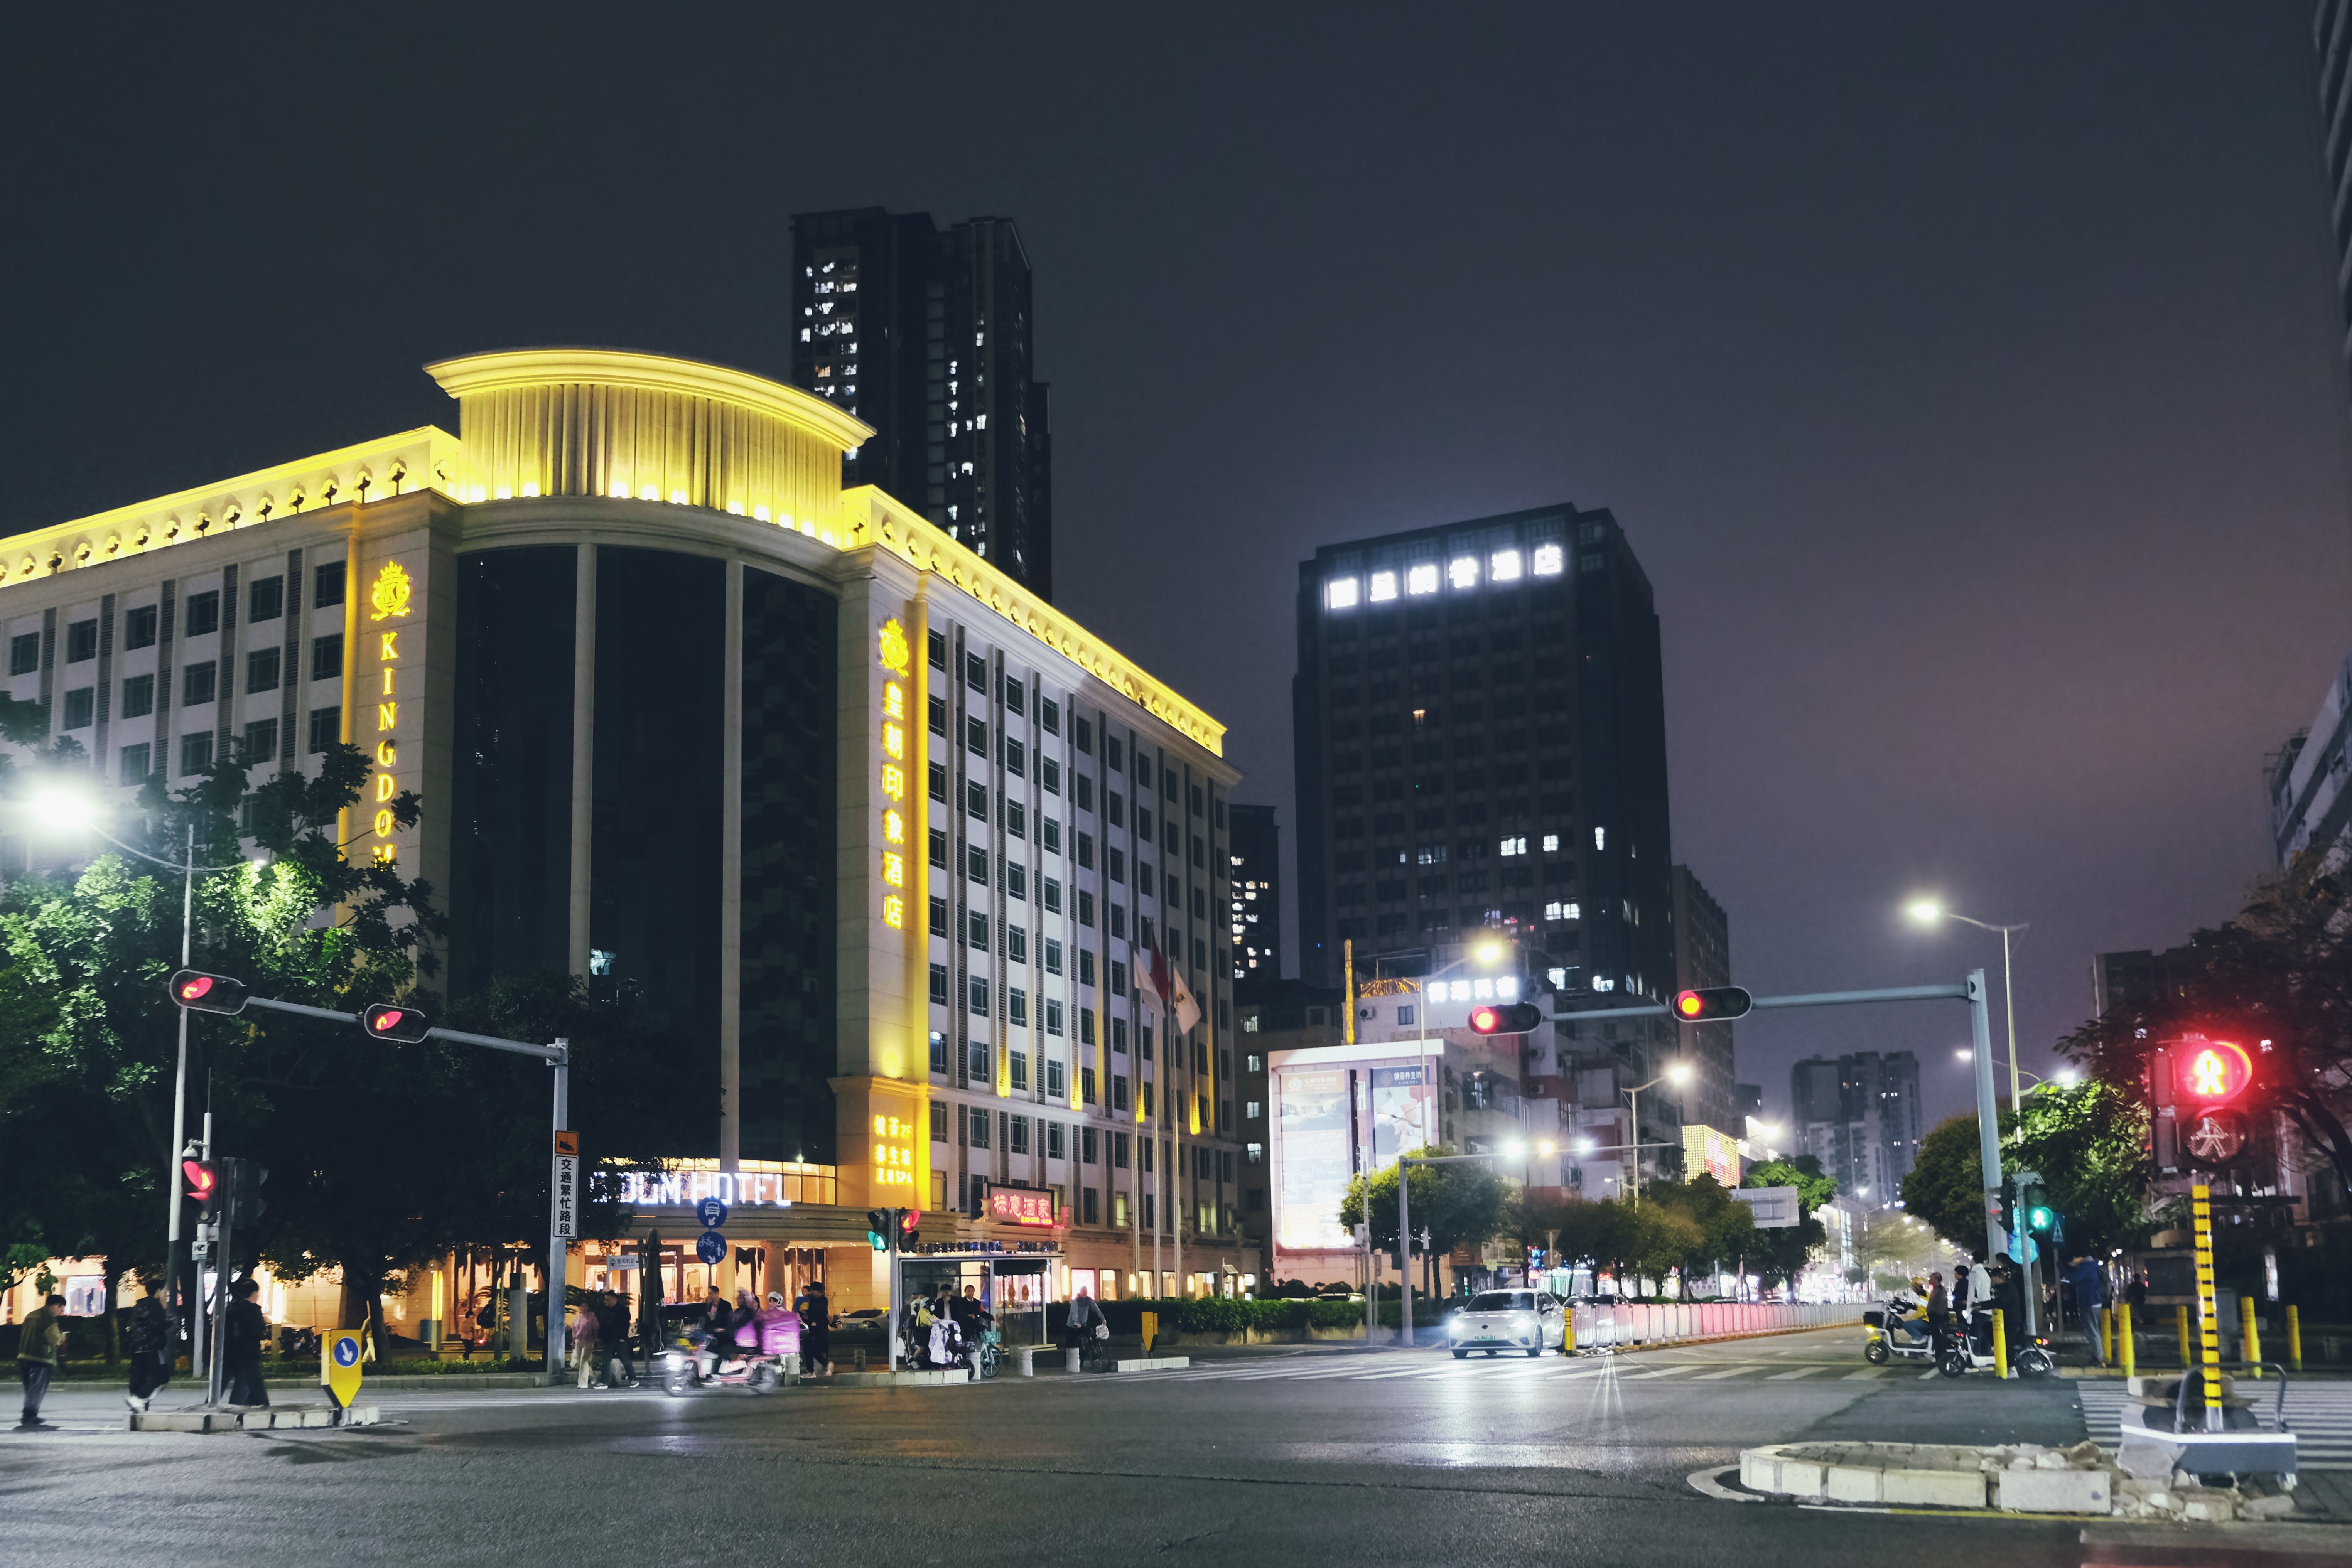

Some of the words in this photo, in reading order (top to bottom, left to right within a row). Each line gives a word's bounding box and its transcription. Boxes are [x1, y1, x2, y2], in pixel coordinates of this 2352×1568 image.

[558, 1158, 572, 1235] 交通繁忙路段
[692, 1172, 792, 1206] HOTEL
